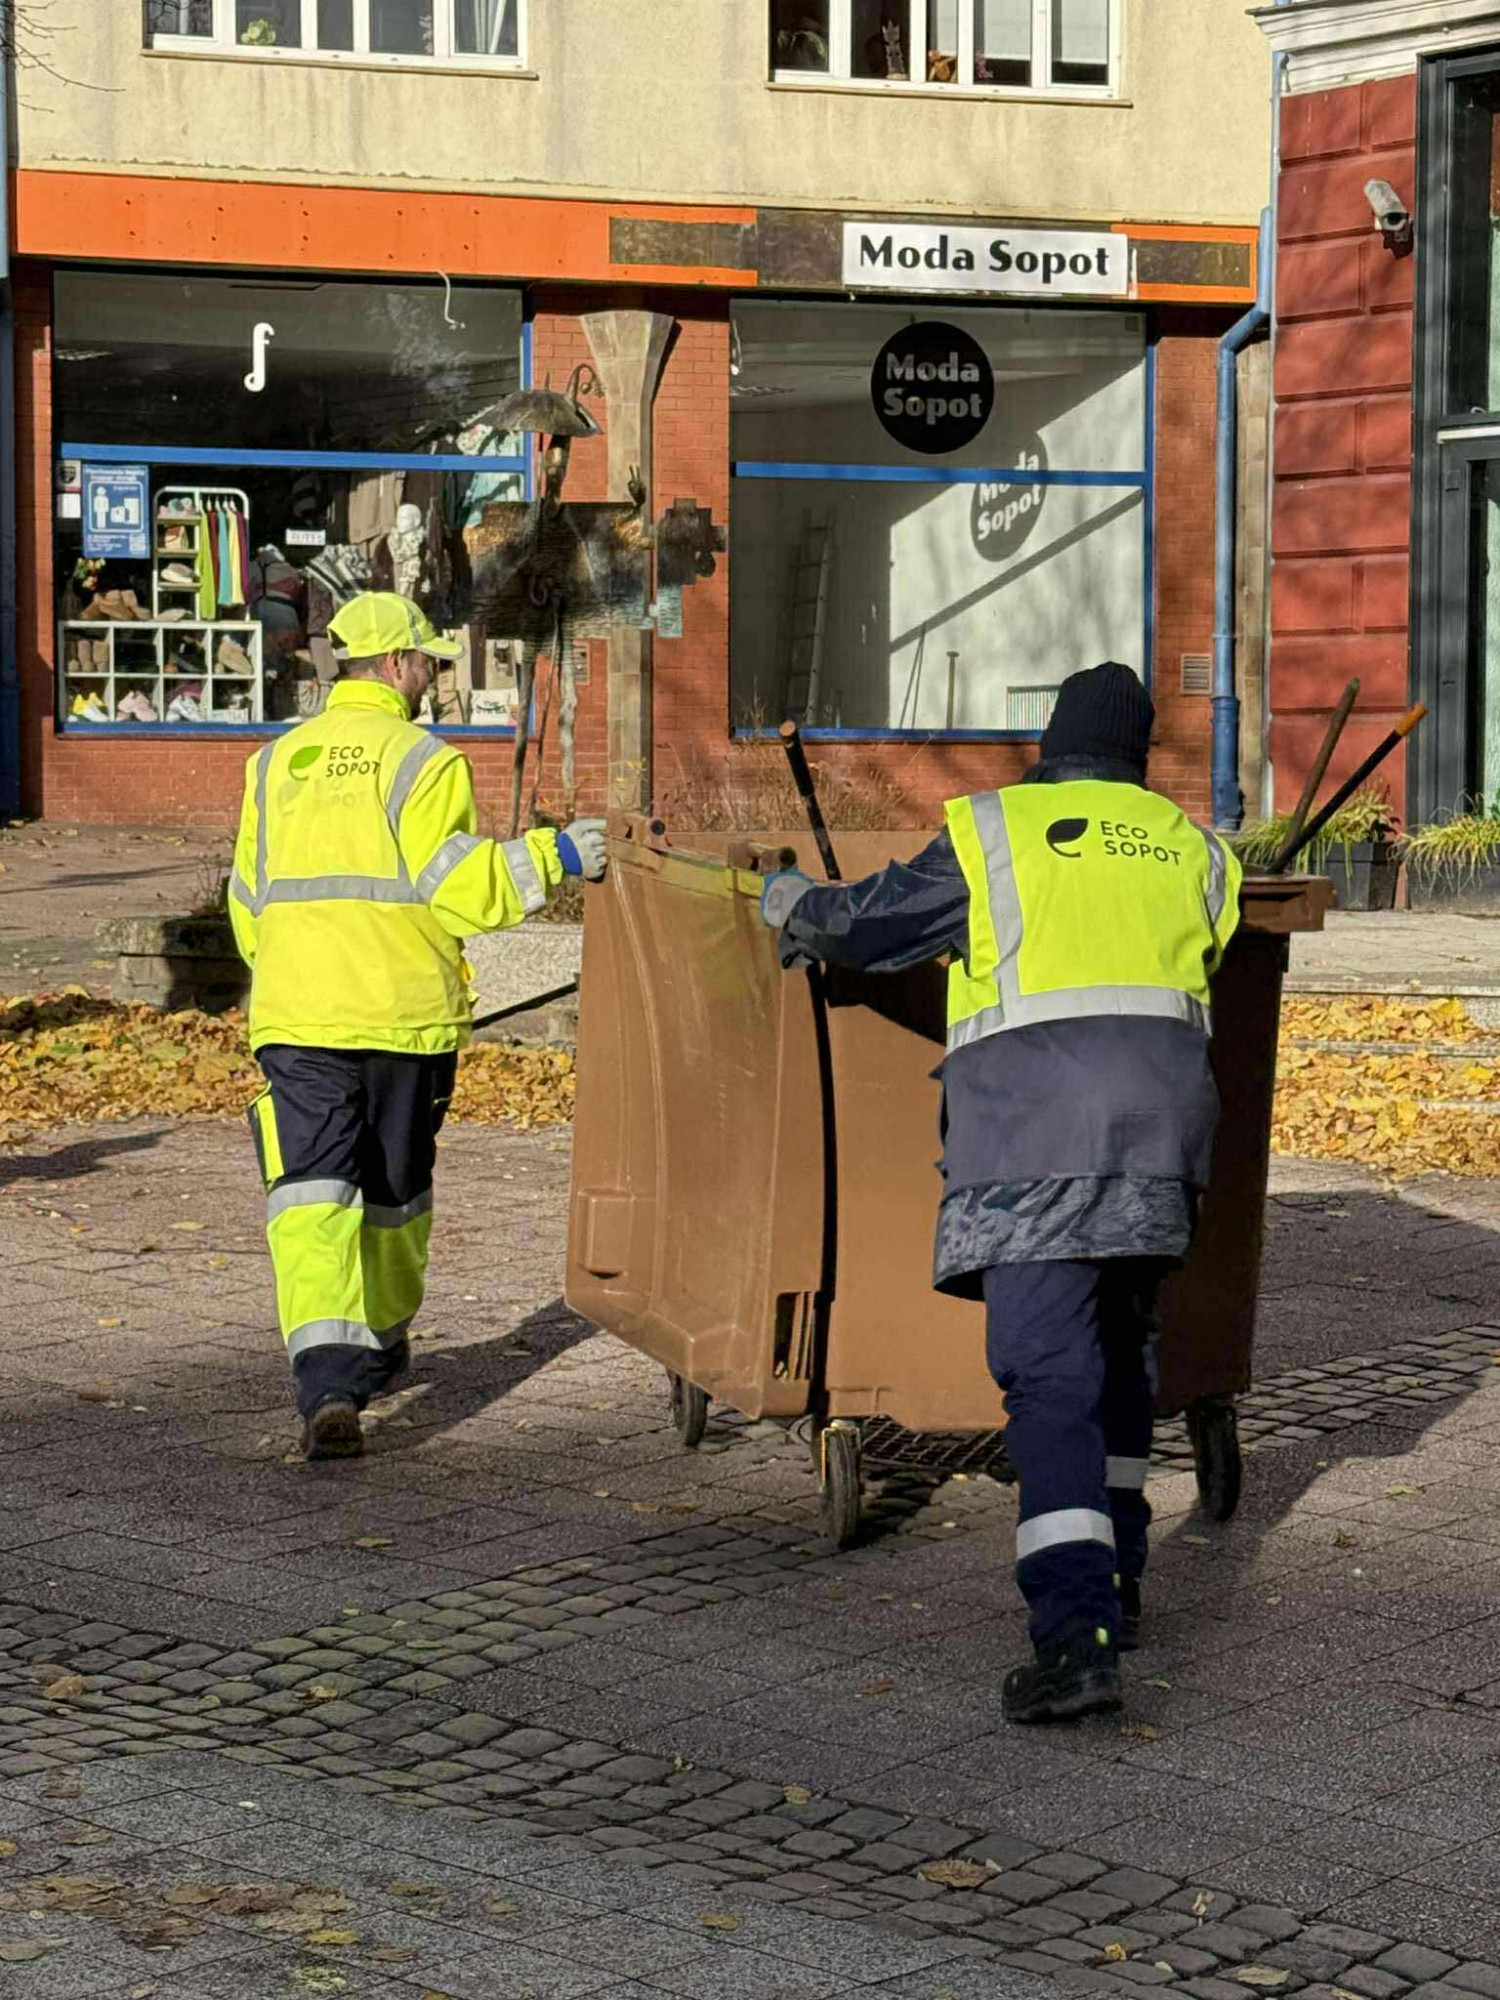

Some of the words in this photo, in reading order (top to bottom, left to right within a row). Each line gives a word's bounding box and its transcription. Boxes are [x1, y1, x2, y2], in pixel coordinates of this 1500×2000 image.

[860, 234, 975, 271] Moda
[988, 239, 1109, 285] Sopot
[886, 351, 980, 382] Moda
[883, 387, 983, 425] Sopot
[328, 746, 364, 760] ECO
[326, 761, 380, 778] SOPOT
[1100, 821, 1148, 839] ECO
[1104, 840, 1181, 866] SOPOT
